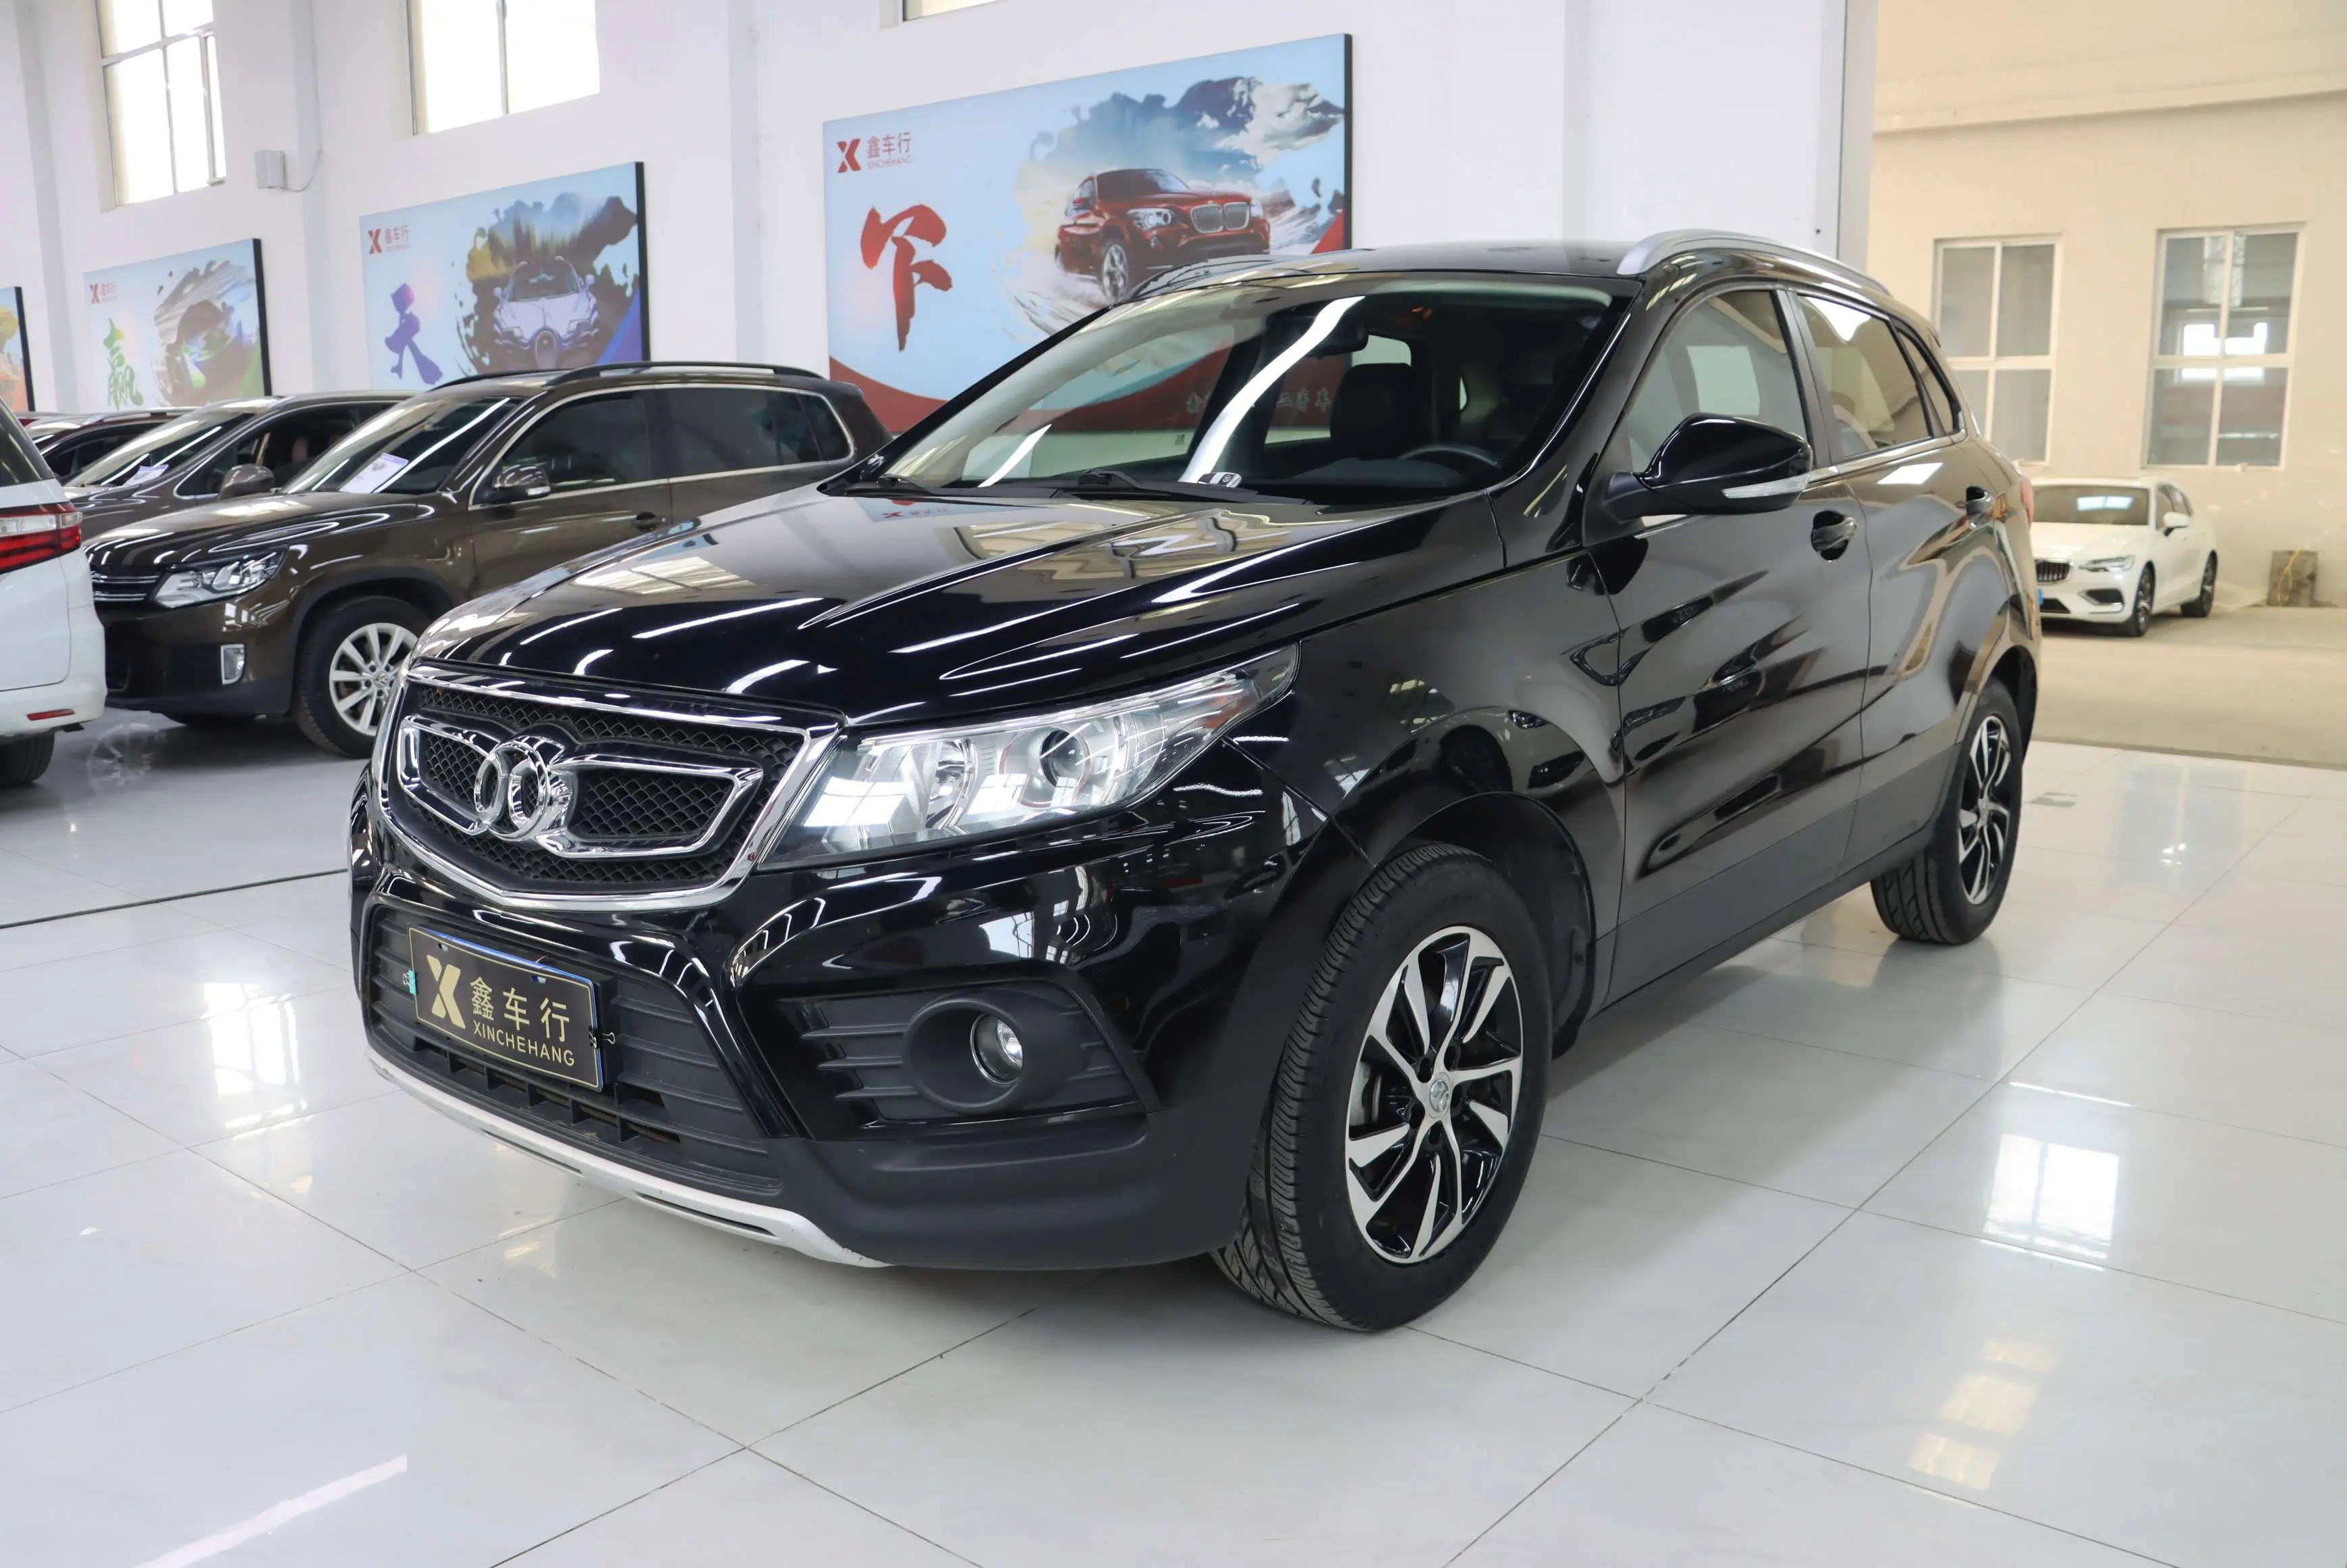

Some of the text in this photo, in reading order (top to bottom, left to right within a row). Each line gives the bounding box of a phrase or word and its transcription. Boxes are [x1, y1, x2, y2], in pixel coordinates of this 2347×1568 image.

[867, 132, 912, 158] 鑫车行
[470, 977, 570, 1042] 鑫车行
[473, 1019, 575, 1067] XINCHEHANG
